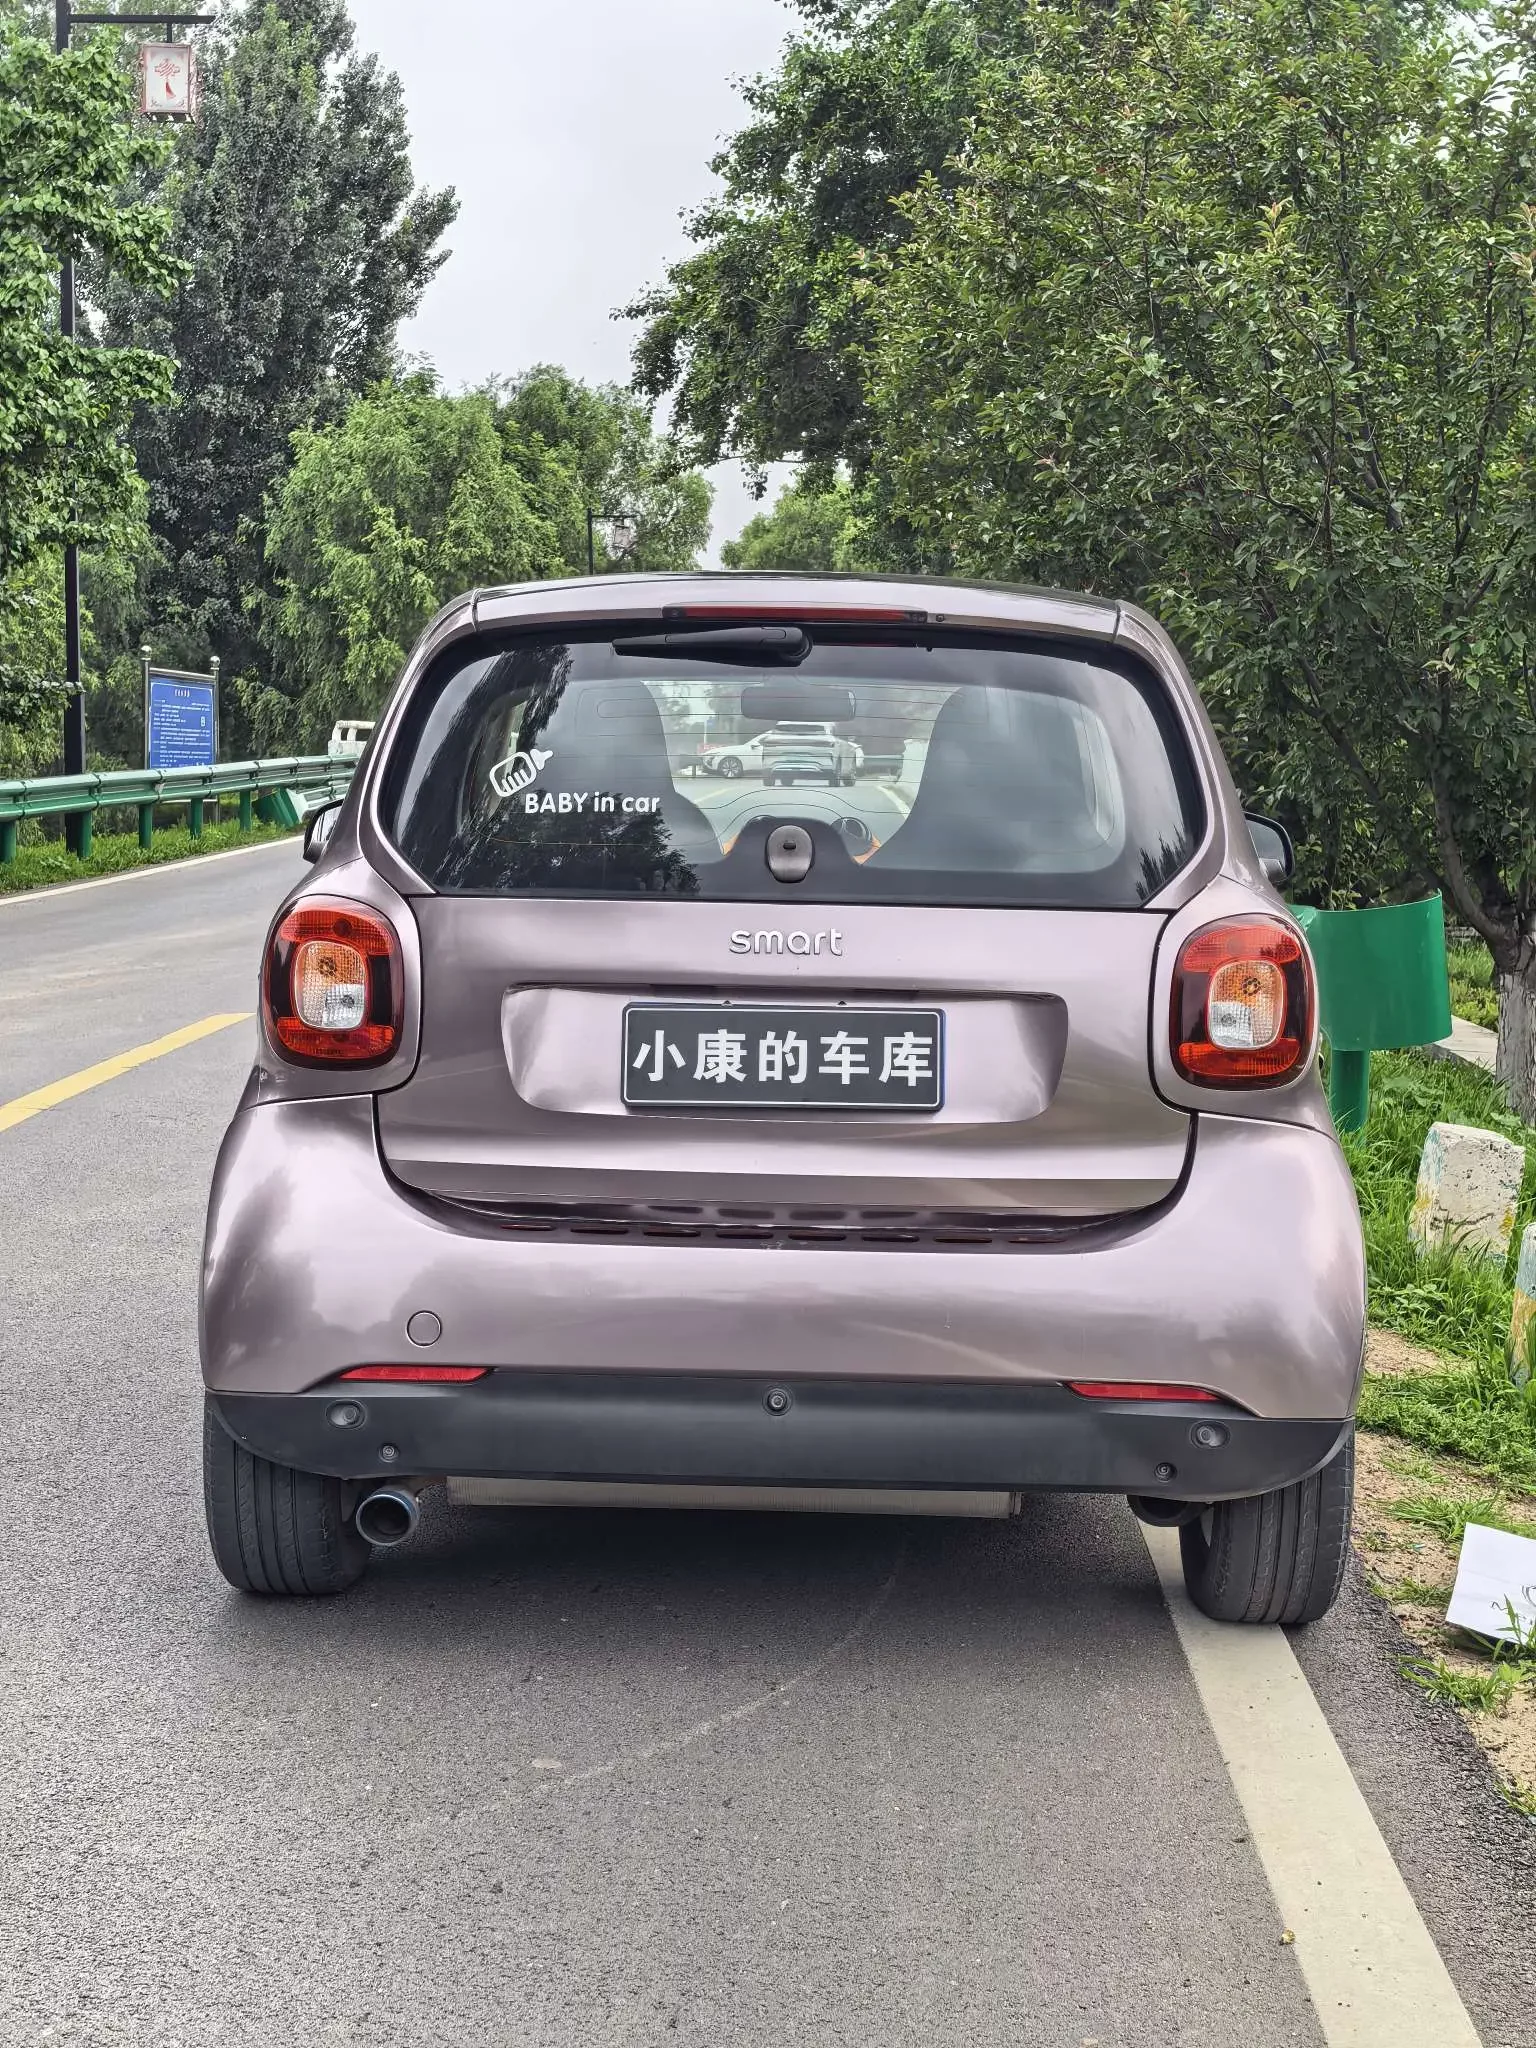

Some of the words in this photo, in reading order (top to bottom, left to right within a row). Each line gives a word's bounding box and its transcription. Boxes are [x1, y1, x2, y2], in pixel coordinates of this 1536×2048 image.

[524, 792, 589, 814] BABY
[593, 791, 615, 813] in
[621, 796, 661, 813] car
[729, 927, 843, 956] smart
[632, 1028, 934, 1087] 小康的车库
